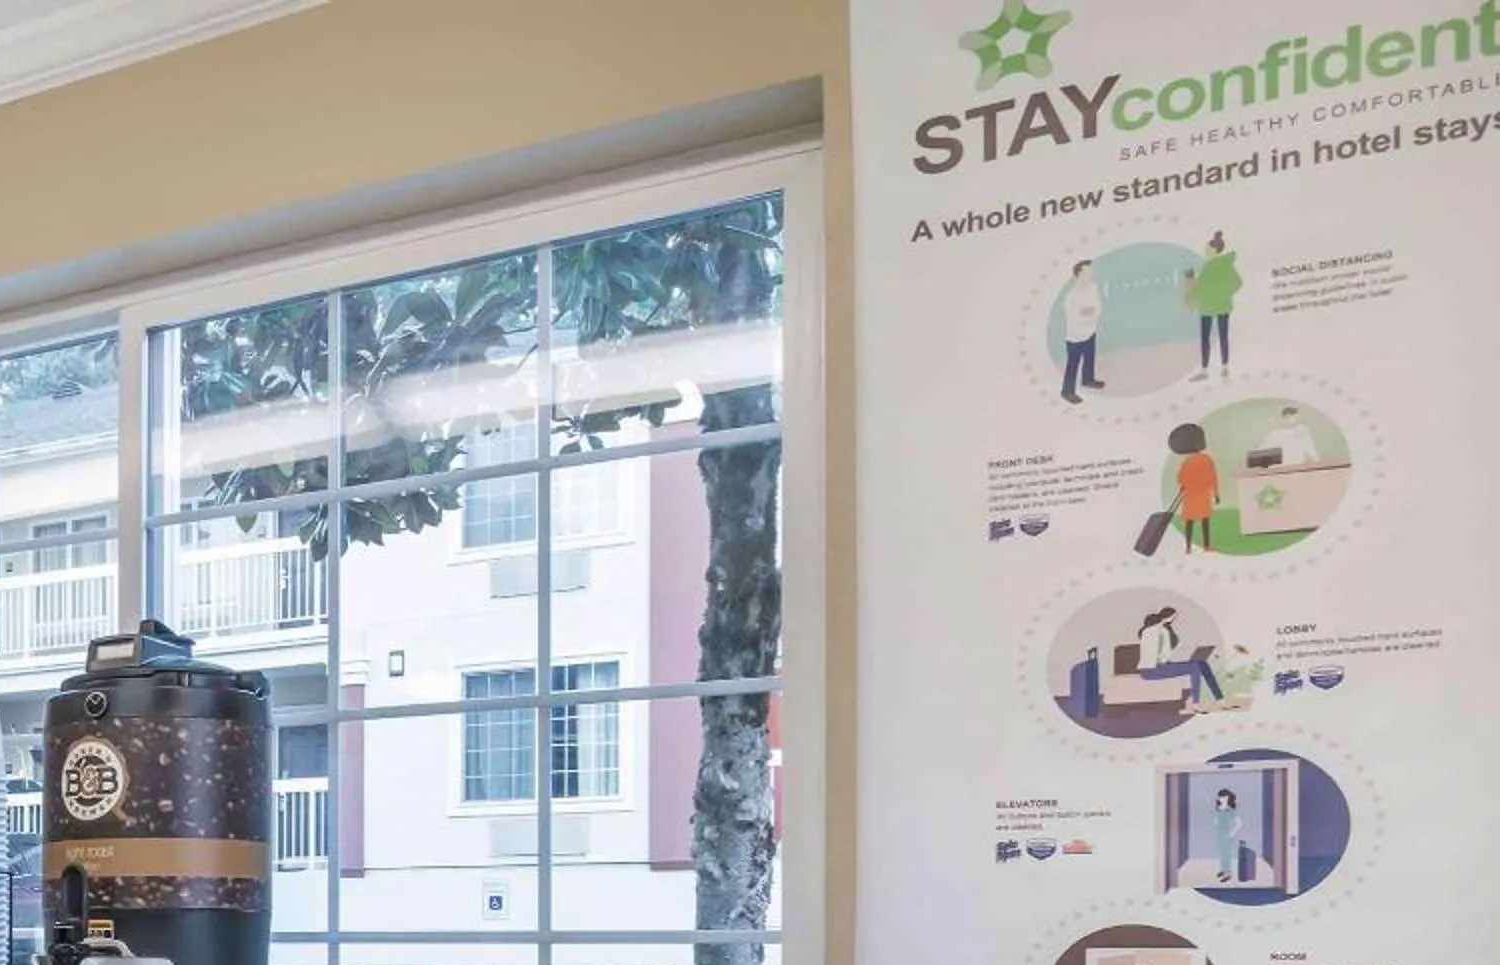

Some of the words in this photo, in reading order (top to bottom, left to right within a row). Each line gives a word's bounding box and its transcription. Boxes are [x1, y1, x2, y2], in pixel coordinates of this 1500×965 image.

[1119, 137, 1177, 161] SAFE
[1190, 113, 1299, 147] HEALTHY
[911, 219, 933, 242] A
[942, 203, 1030, 238] whole
[1041, 189, 1104, 218] new
[1113, 152, 1259, 203] standard
[1271, 148, 1300, 172] in
[1313, 125, 1400, 164] hotel
[1272, 263, 1315, 277] SOCIAL
[1276, 624, 1317, 635] LOBBY
[996, 799, 1058, 809] ELEVATORS
